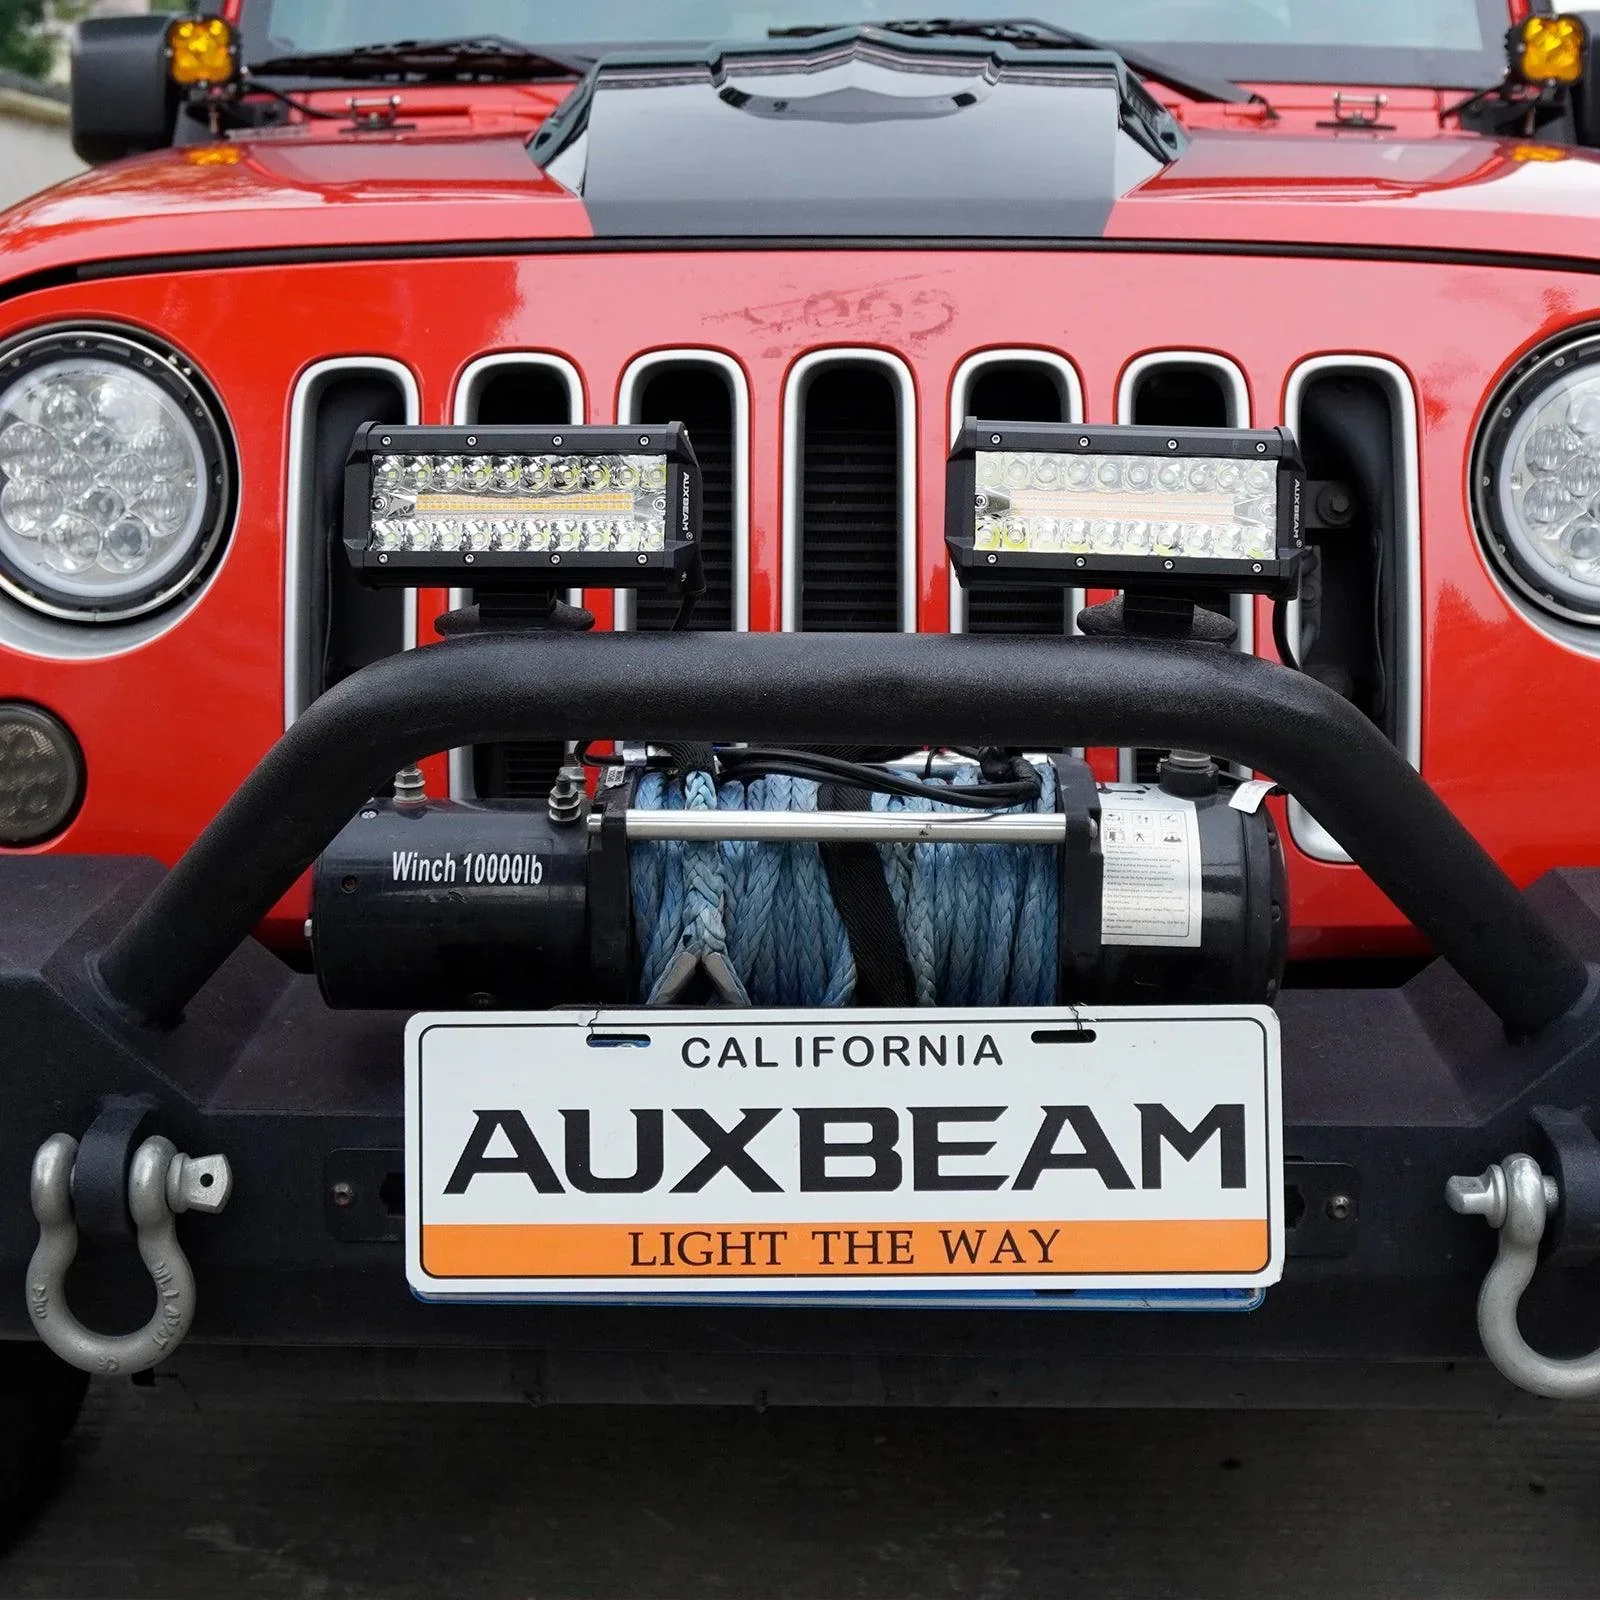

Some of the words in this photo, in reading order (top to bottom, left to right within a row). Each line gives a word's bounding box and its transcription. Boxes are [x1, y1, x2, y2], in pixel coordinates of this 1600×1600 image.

[392, 852, 456, 883] Winch
[463, 852, 543, 884] 10000lb
[681, 1034, 1004, 1068] CALIFORNIA
[442, 1103, 1247, 1194] AUXBEAM
[628, 1231, 788, 1267] LIGHT
[812, 1230, 915, 1265] THE
[939, 1228, 1061, 1264] WAY
